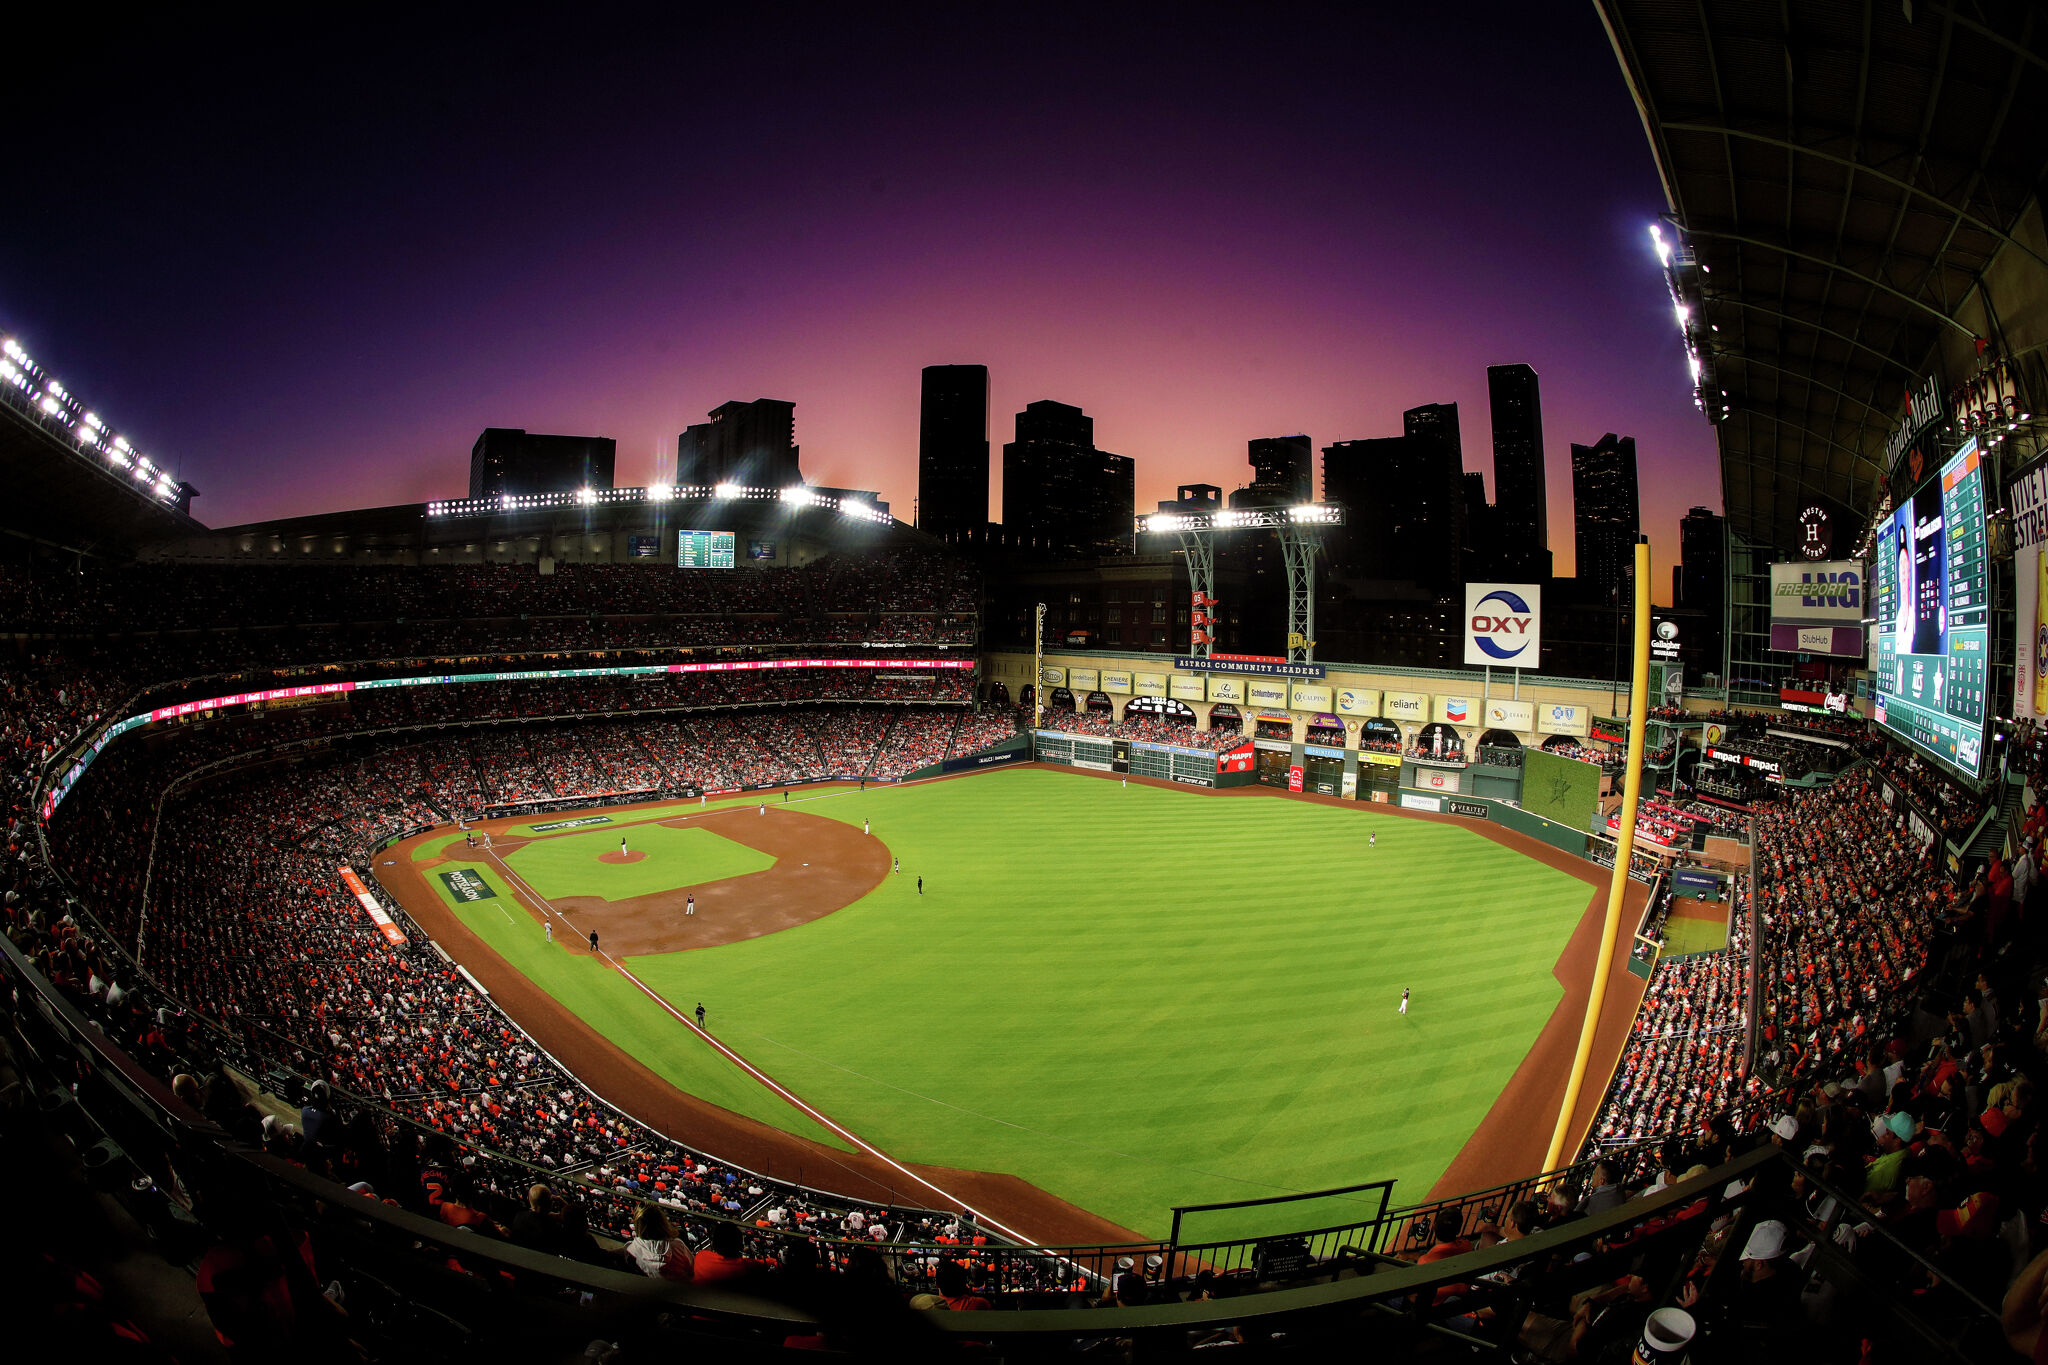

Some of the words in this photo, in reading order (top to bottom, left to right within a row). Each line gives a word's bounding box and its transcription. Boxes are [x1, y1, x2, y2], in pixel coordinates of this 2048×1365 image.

[1886, 417, 1912, 474] Minute
[1910, 375, 1939, 433] Maid
[2011, 472, 2037, 515] VIVE
[1799, 506, 1827, 523] HOUSTON
[1806, 523, 1818, 541] H
[1801, 543, 1827, 557] ASTROS
[1777, 583, 1848, 595] FREEPORT
[1802, 571, 1860, 608] LNG
[1193, 594, 1201, 602] 05
[1472, 616, 1532, 634] OXY
[1193, 632, 1200, 640] 21
[1291, 636, 1299, 644] 17
[1802, 634, 1828, 644] StubHub
[1651, 640, 1681, 650] Gallagher
[1179, 660, 1211, 668] ASTROS
[1214, 662, 1273, 673] COMMUNITY
[1276, 666, 1320, 675] LEADERS
[1212, 692, 1240, 700] LEXUS
[1251, 689, 1284, 700] Schlumberger
[1390, 699, 1419, 710] reliant
[1781, 702, 1809, 713] HORNITOS
[1509, 712, 1530, 720] QUANTA
[1591, 728, 1624, 743] Budweiser
[1712, 751, 1741, 763] impact
[1748, 758, 1779, 772] impact
[1458, 805, 1486, 814] VERITEX
[449, 871, 481, 901] POSTSEASON
[427, 1183, 443, 1205] 2
